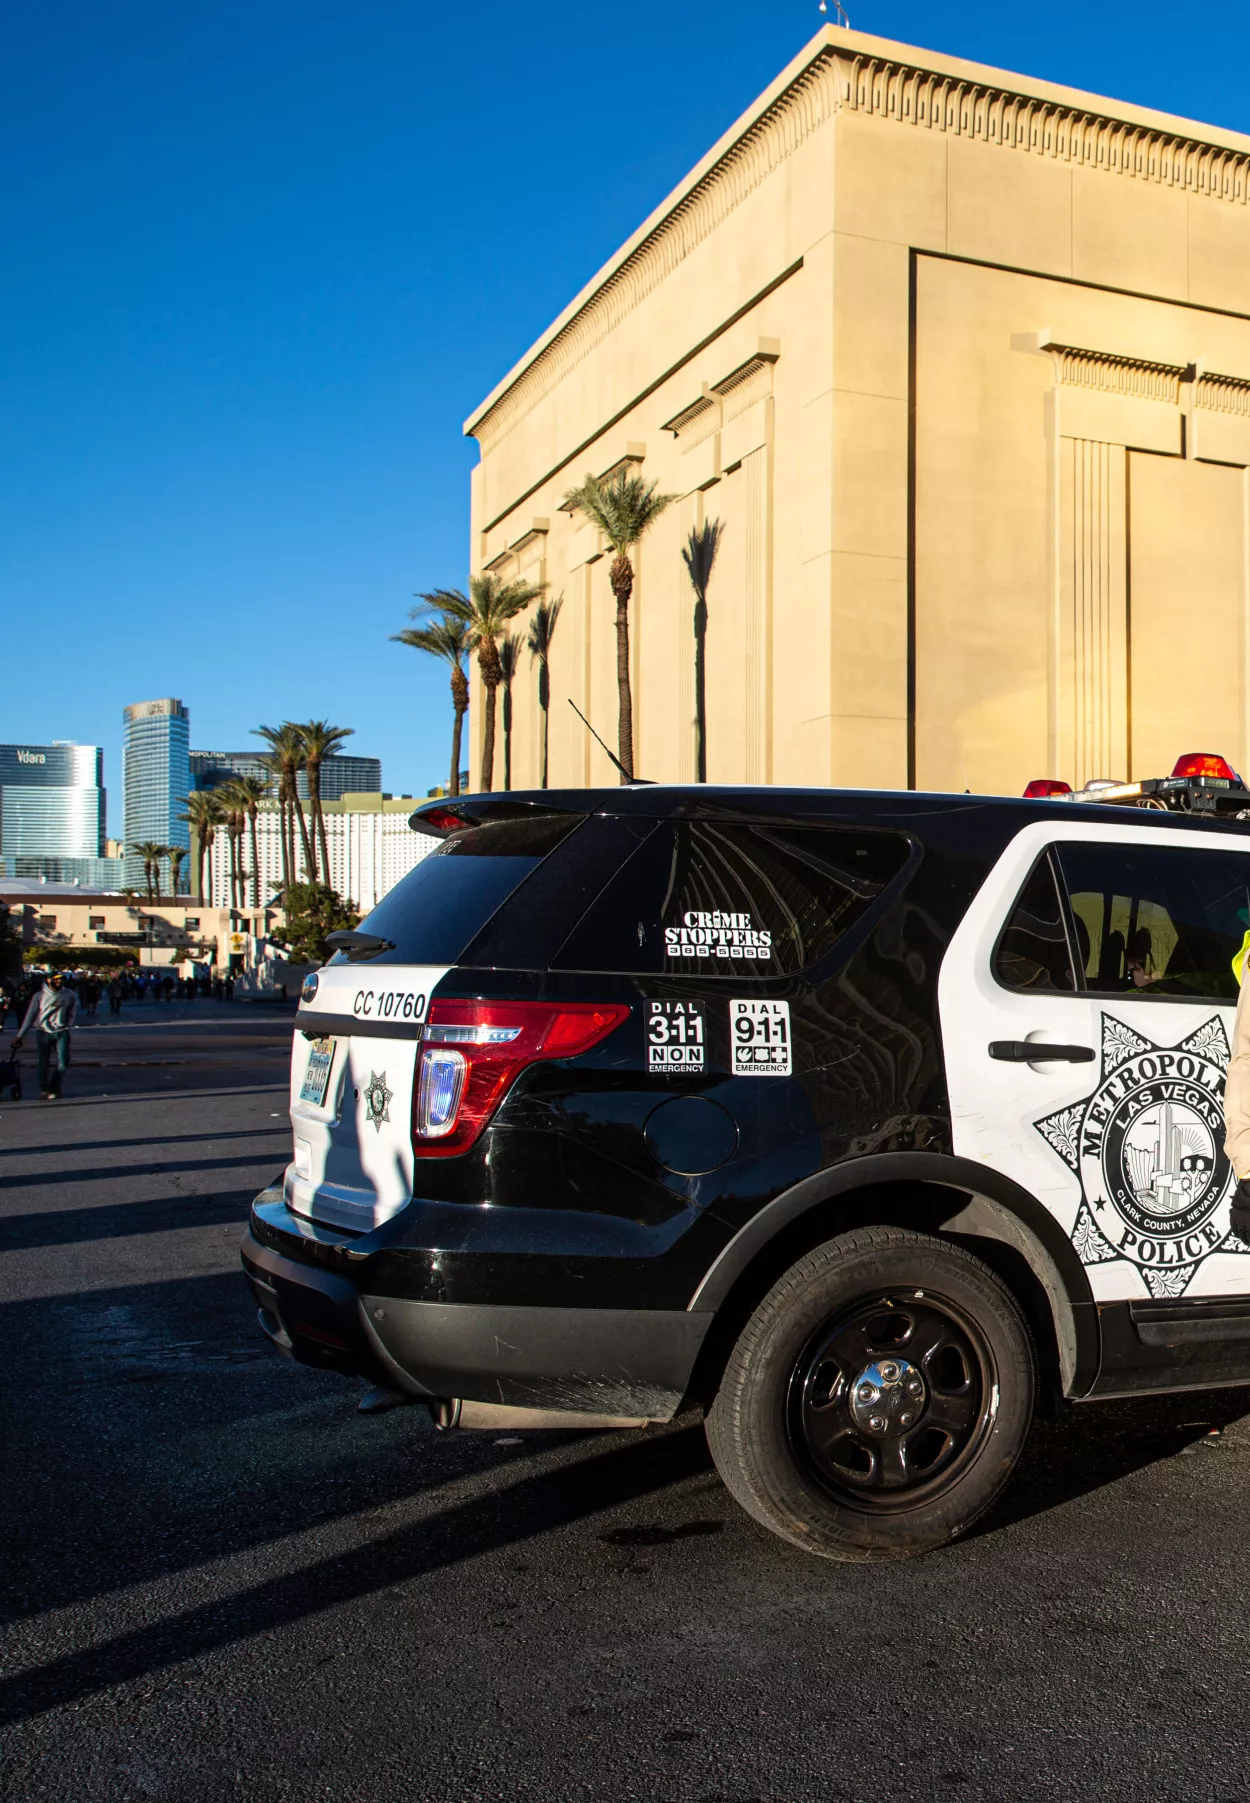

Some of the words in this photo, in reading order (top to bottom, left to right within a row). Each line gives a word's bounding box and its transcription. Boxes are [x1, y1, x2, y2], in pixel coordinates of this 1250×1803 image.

[17, 749, 46, 764] Vdara
[665, 928, 771, 947] STOPPERS
[667, 945, 770, 959] 385-5555
[354, 990, 374, 1015] CC
[378, 992, 426, 1019] 10760
[652, 1003, 698, 1014] DIAL
[738, 1004, 781, 1014] DIAL
[652, 1048, 701, 1062] NON
[649, 1065, 704, 1073] EMERGENCY
[1116, 1090, 1153, 1129] LAS
[1161, 1085, 1221, 1129] VEGAS
[1117, 1189, 1142, 1222] CLARK
[1144, 1219, 1185, 1231] COUNTY,
[1187, 1186, 1220, 1222] NEVADA
[1117, 1221, 1222, 1264] POLICE
